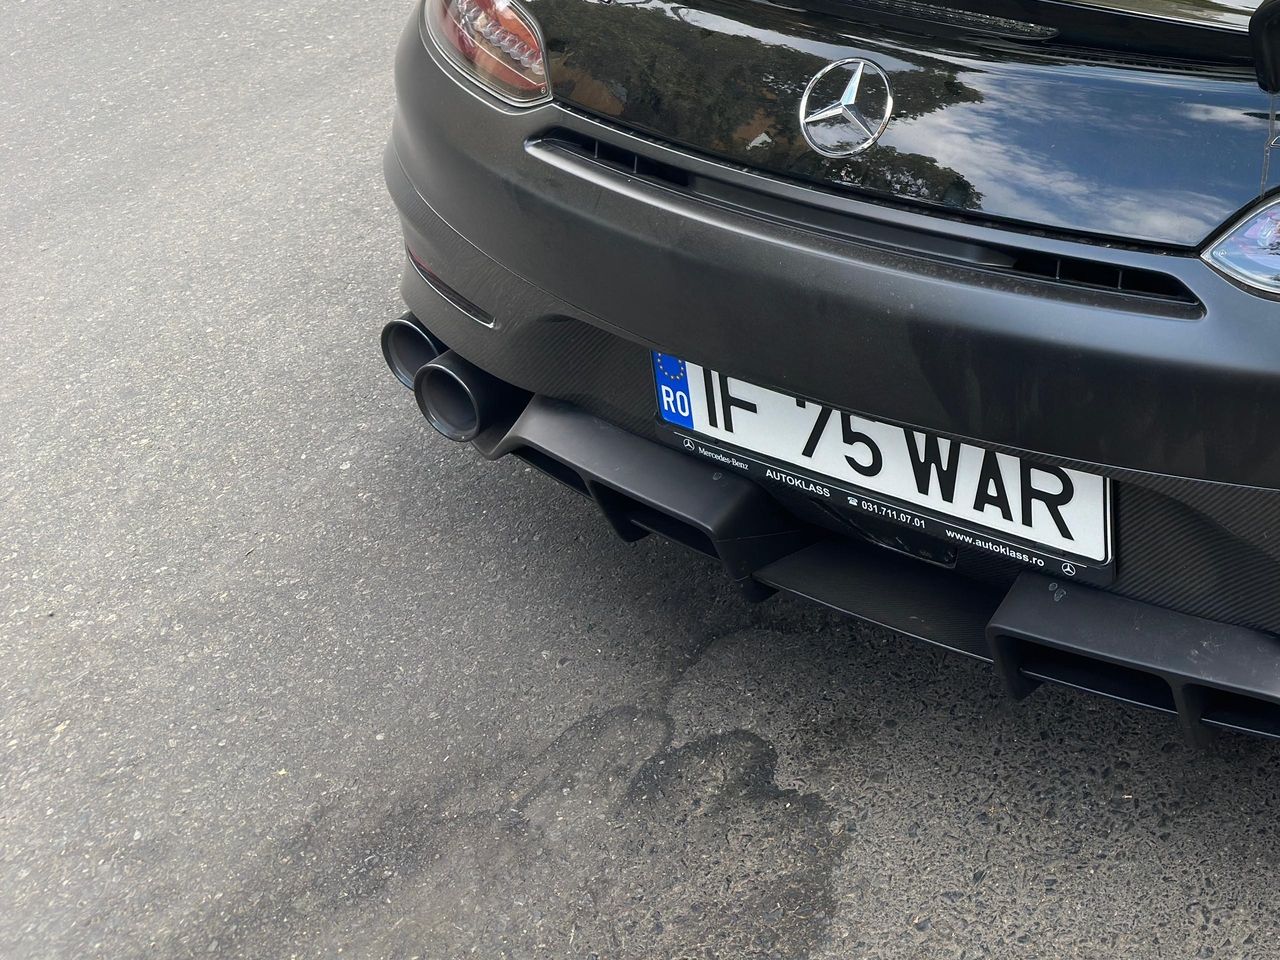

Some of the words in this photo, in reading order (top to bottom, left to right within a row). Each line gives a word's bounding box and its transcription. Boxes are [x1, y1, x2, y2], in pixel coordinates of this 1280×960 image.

[661, 384, 690, 417] RO
[698, 446, 750, 471] Mercedes-Benz
[765, 468, 832, 498] AUTOKLASS
[860, 499, 926, 530] 031.711.07.01
[944, 528, 1045, 568] www.autoklass.ro
[795, 397, 884, 478] 75
[903, 427, 1075, 542] WAR
